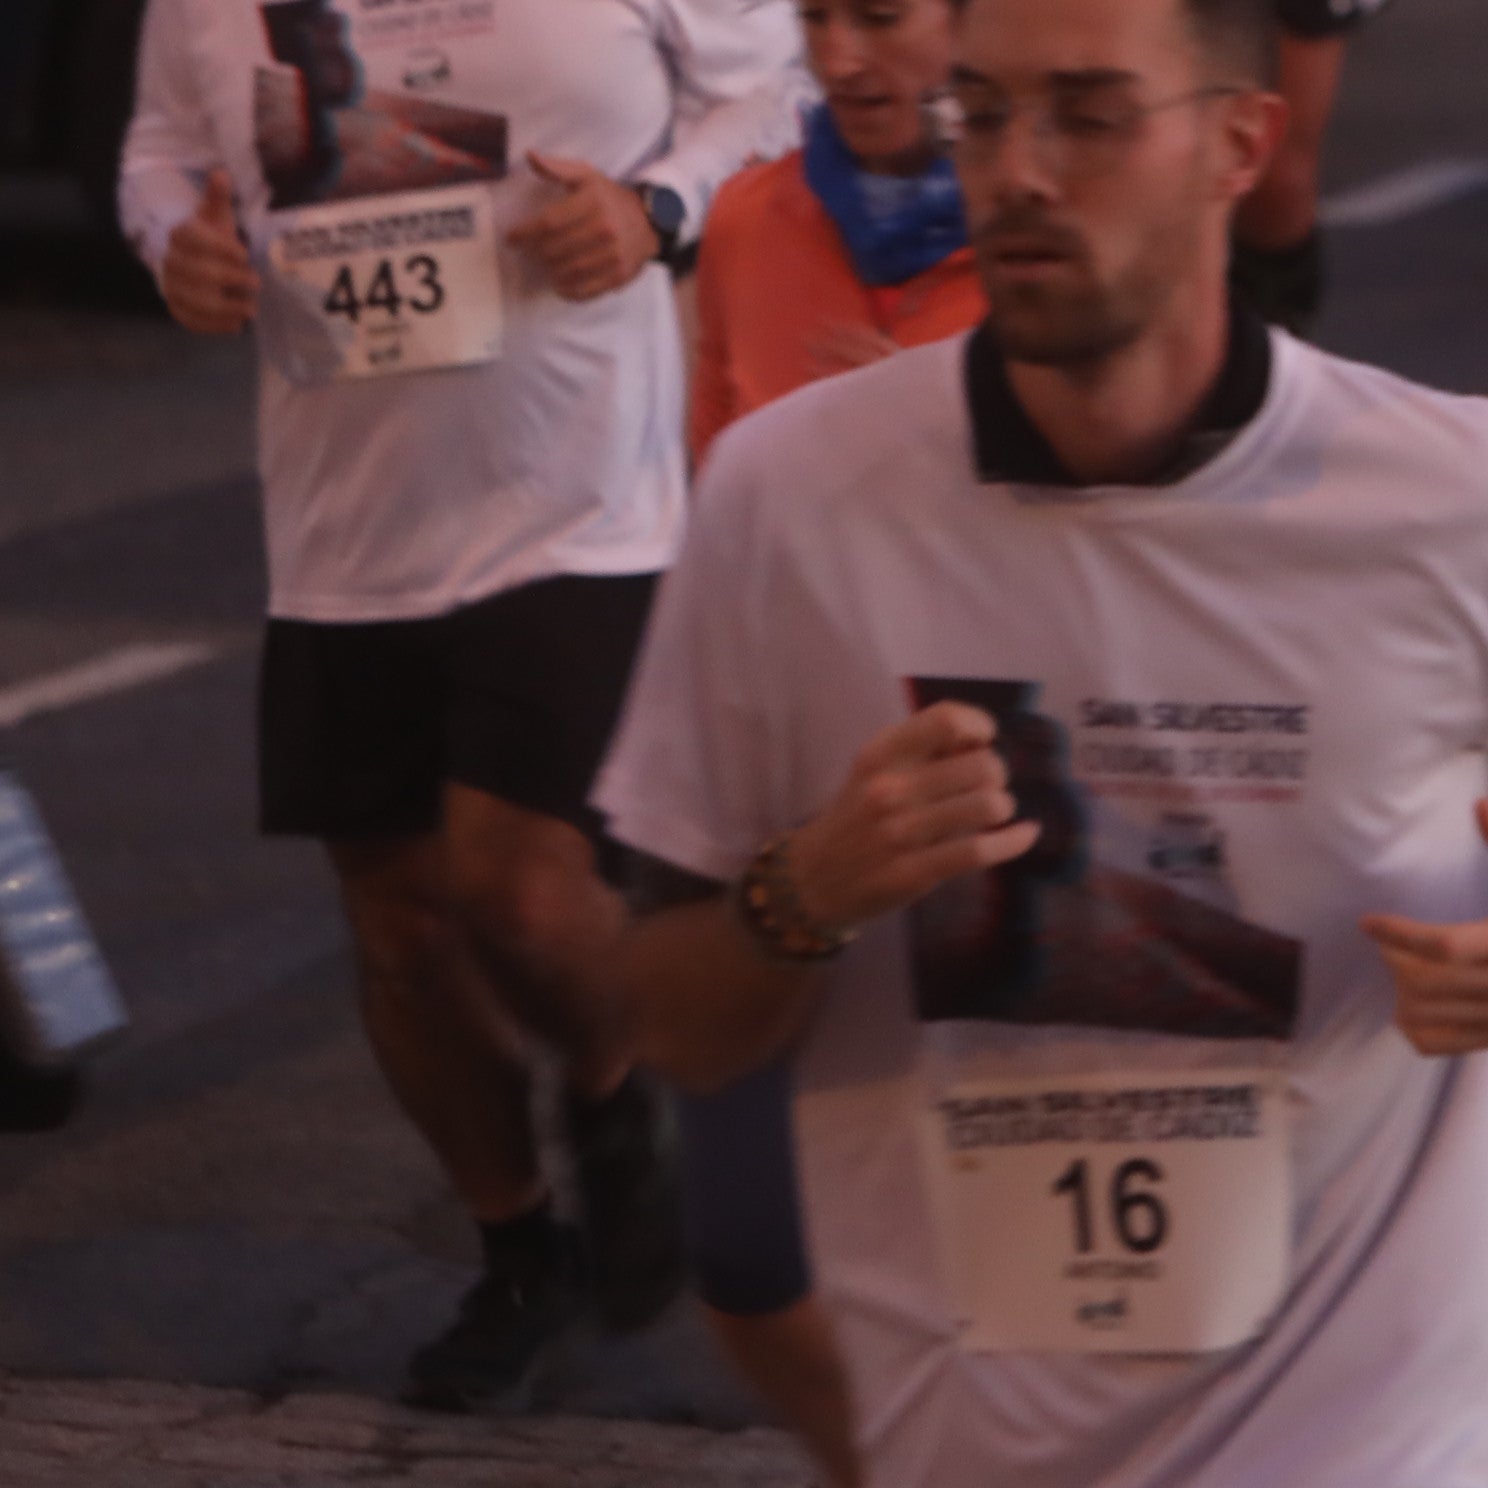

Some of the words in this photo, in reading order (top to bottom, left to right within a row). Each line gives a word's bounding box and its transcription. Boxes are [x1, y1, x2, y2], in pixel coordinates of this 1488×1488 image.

[322, 253, 446, 326] 443
[1153, 700, 1310, 734] SILVESTRE
[1048, 1156, 1171, 1256] 16
